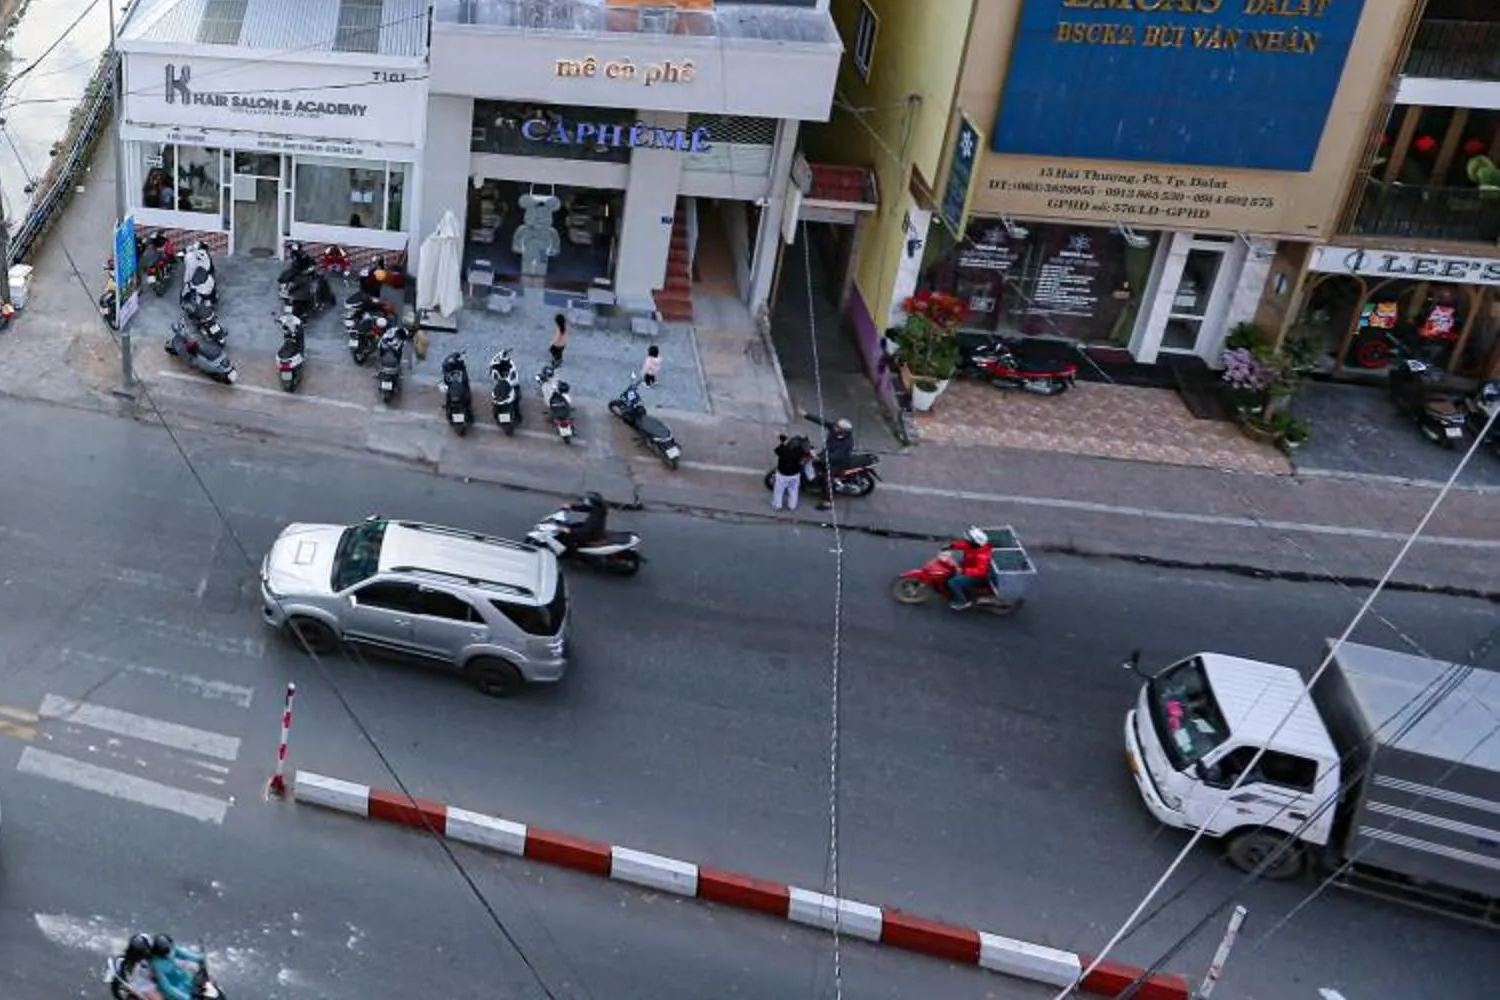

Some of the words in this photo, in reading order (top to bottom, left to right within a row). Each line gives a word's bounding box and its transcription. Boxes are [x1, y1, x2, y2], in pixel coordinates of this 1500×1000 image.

[165, 63, 191, 105] K
[556, 58, 596, 79] mê
[605, 57, 636, 79] cà
[645, 62, 697, 87] phê
[193, 92, 229, 107] HAIR
[231, 95, 280, 111] SALON
[281, 99, 293, 111] &
[294, 101, 368, 117] ACADEMY
[1378, 253, 1500, 281] LEE'S
